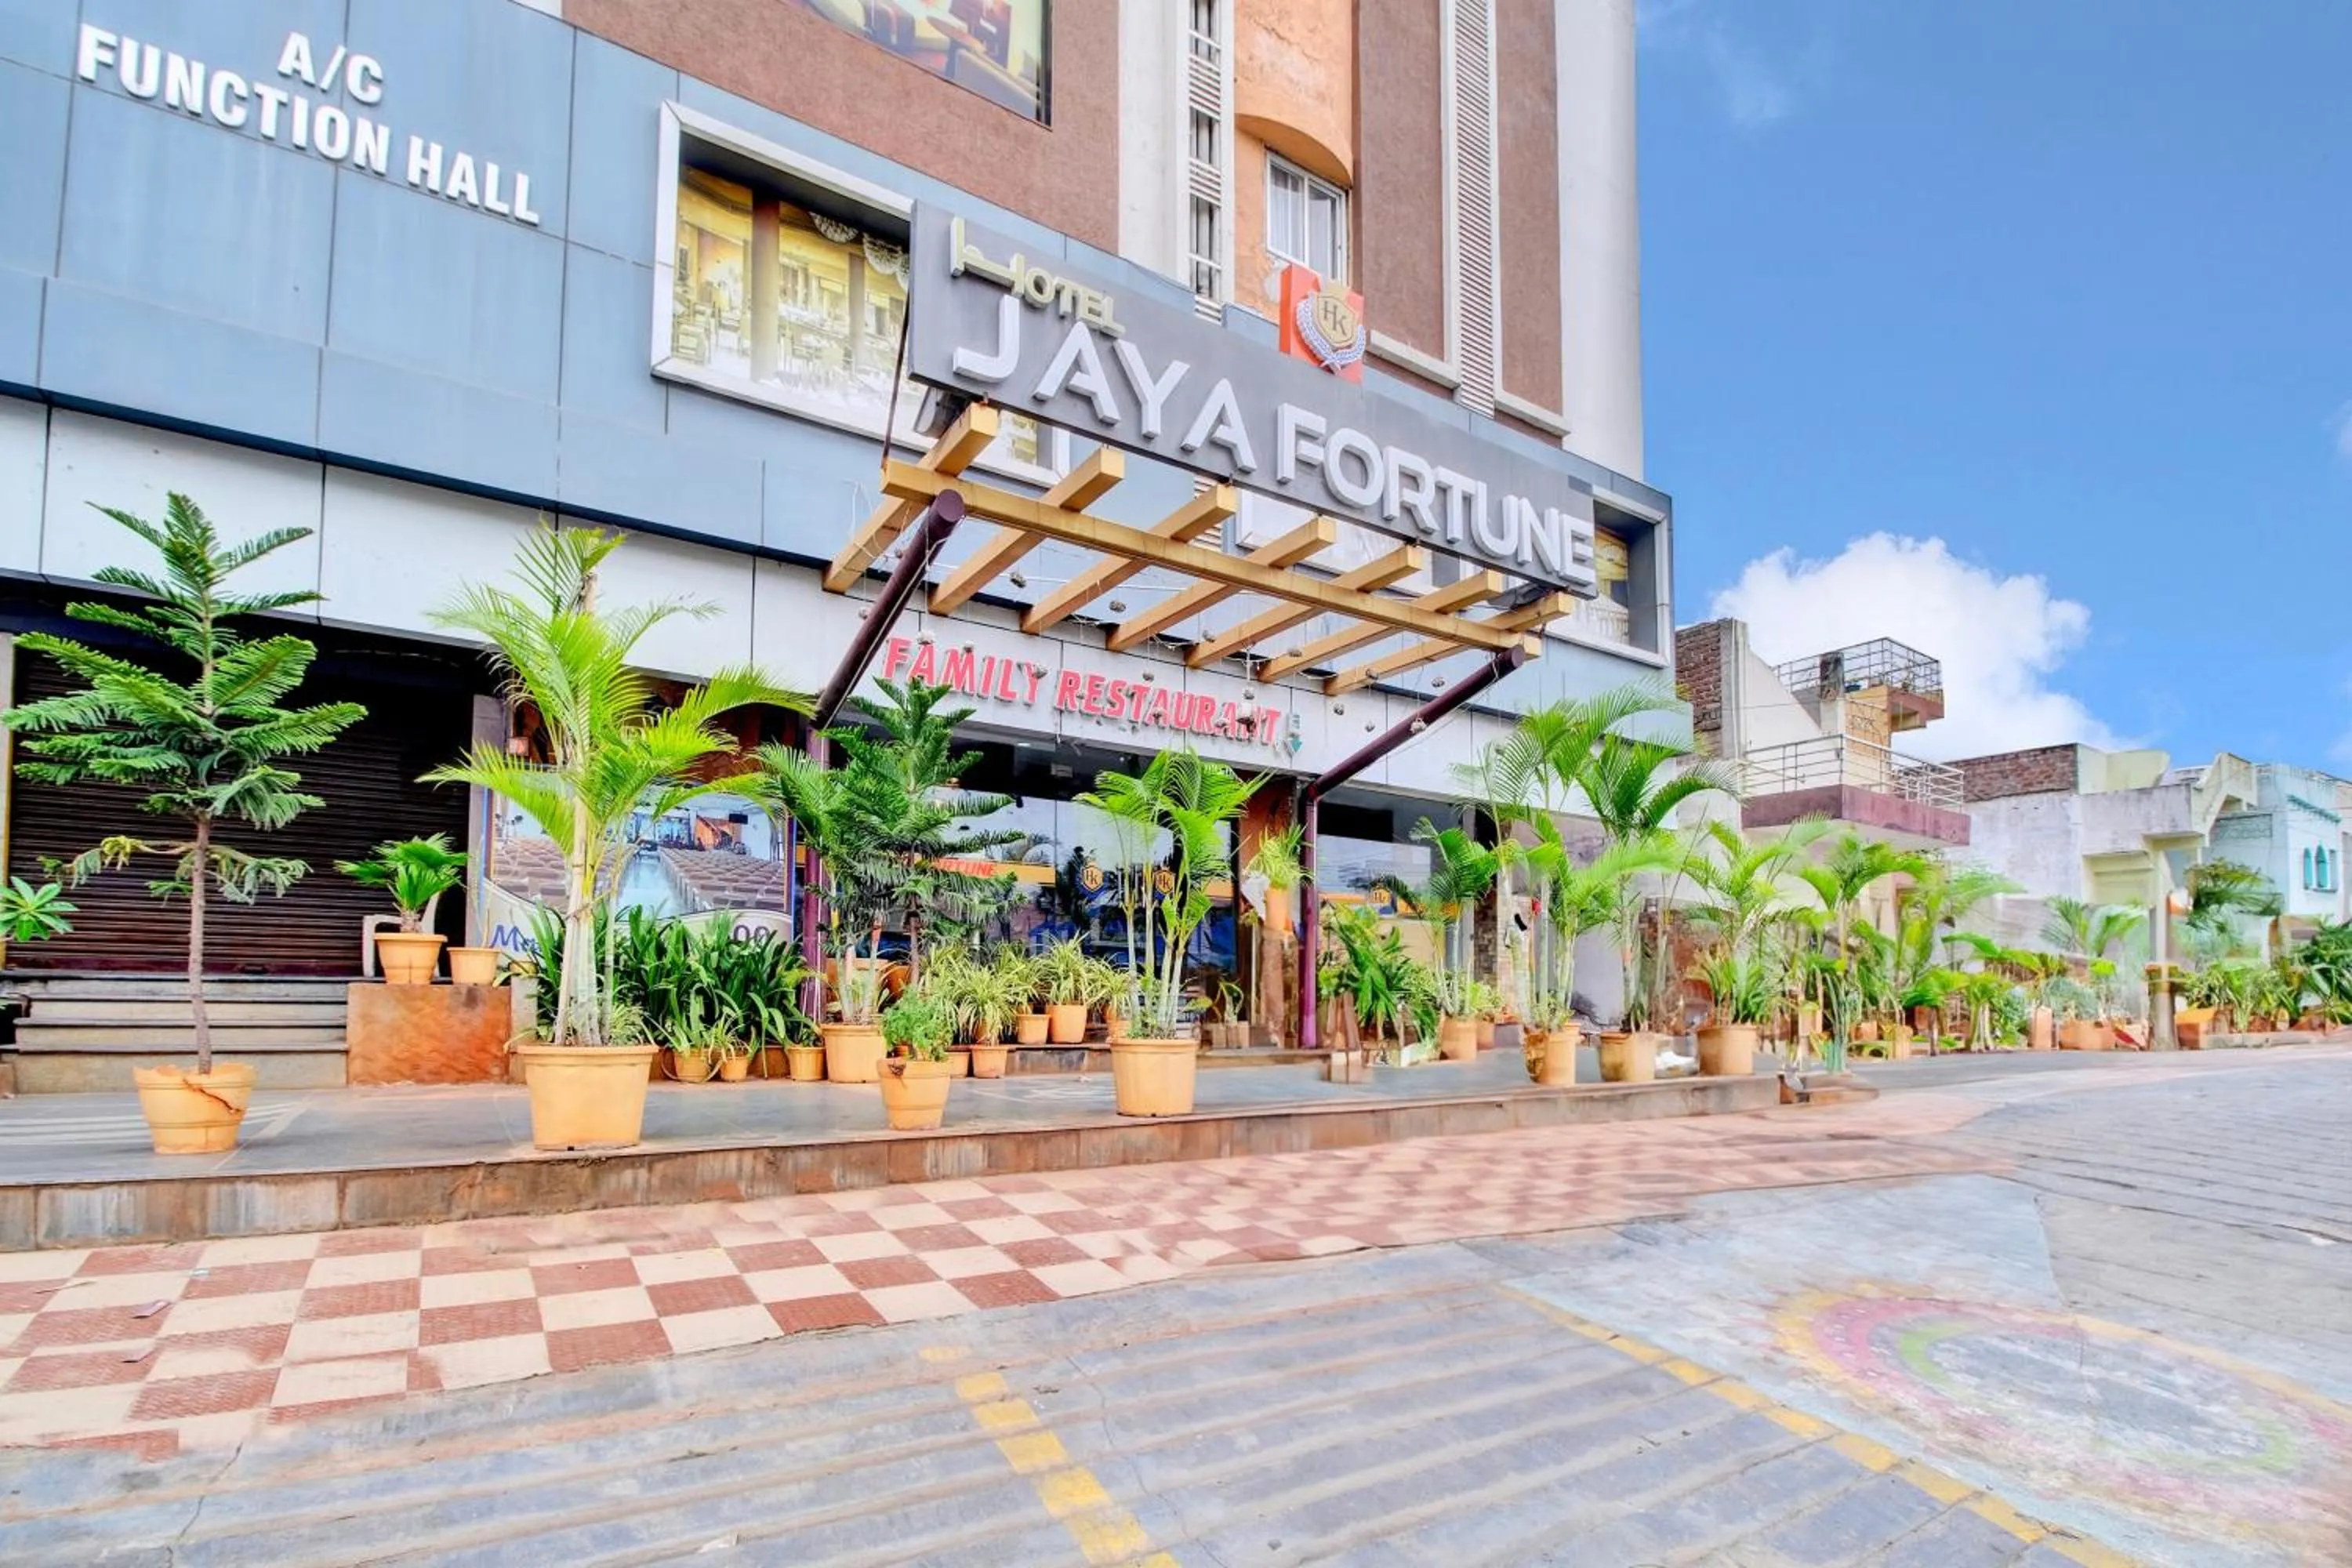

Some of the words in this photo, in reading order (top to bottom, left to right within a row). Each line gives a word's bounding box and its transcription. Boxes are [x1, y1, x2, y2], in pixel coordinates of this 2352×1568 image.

[278, 31, 383, 104] A/C
[78, 22, 390, 176] FUNCTION
[407, 135, 539, 227] HALL
[949, 216, 1127, 338] HOTEL
[1322, 299, 1348, 337] HK
[952, 294, 1257, 475] JAYA
[1276, 401, 1595, 587] FORTUNE
[882, 636, 1047, 706] FAMILY
